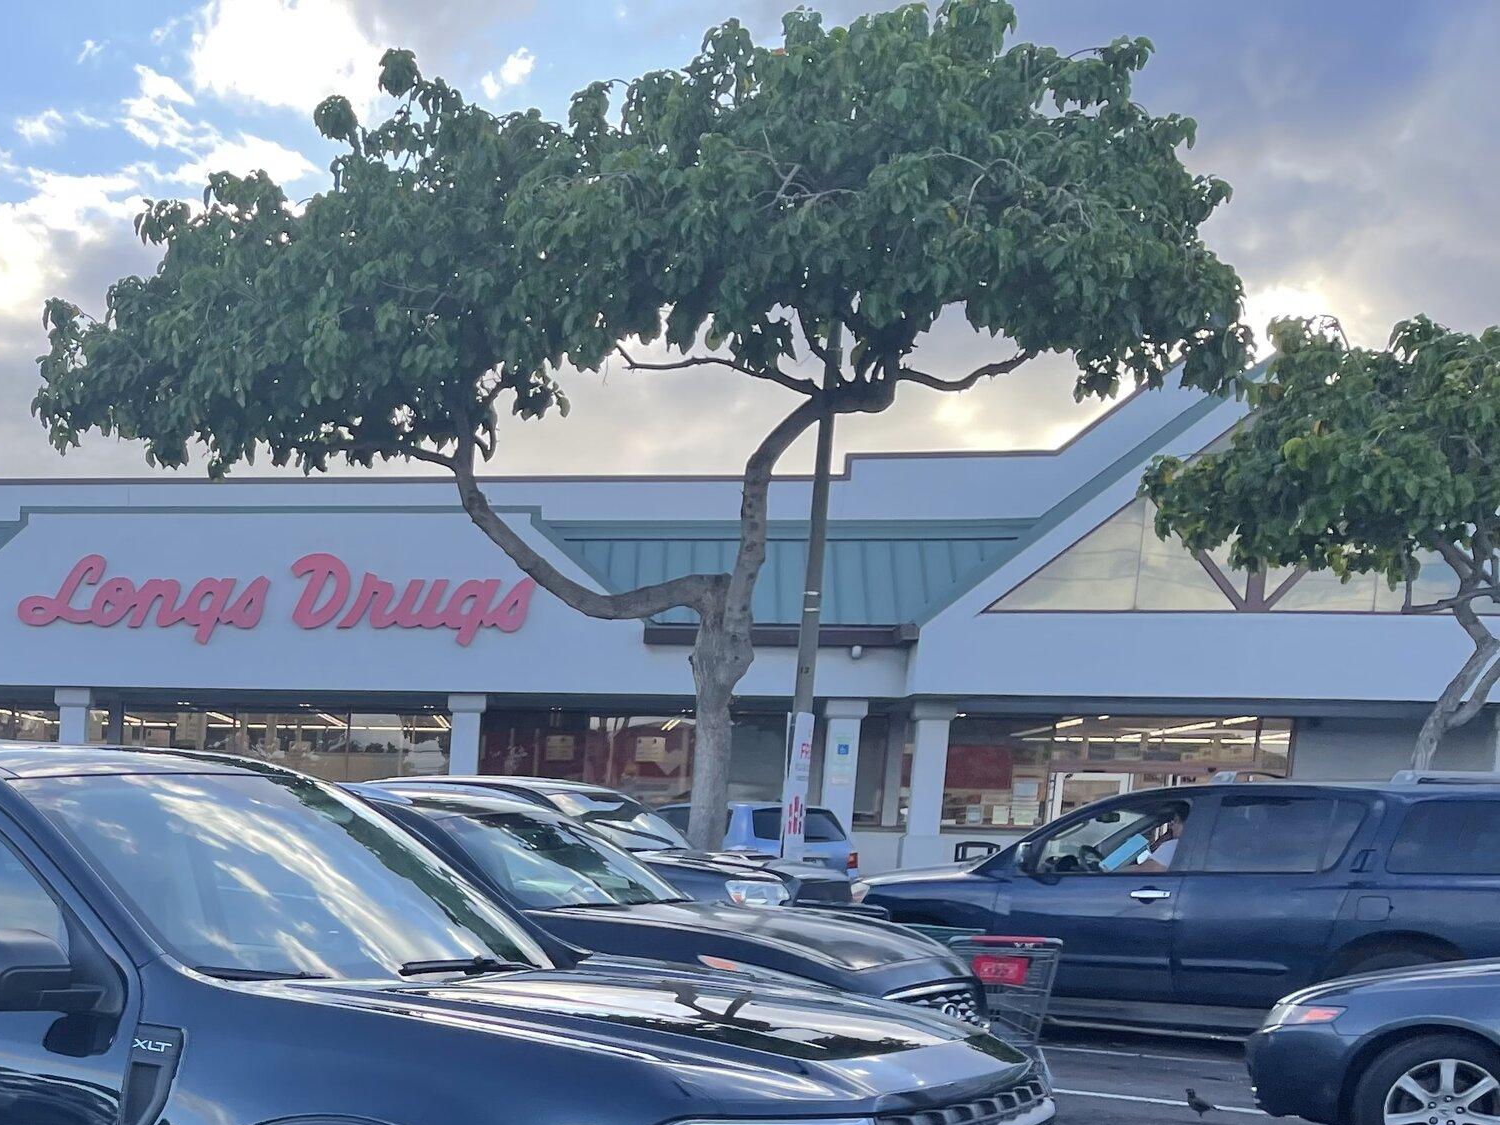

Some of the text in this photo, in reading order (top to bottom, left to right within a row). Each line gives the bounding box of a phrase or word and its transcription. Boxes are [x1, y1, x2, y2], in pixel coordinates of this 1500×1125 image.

[17, 553, 537, 647] Longs Drugs
[132, 1038, 172, 1052] XLT
